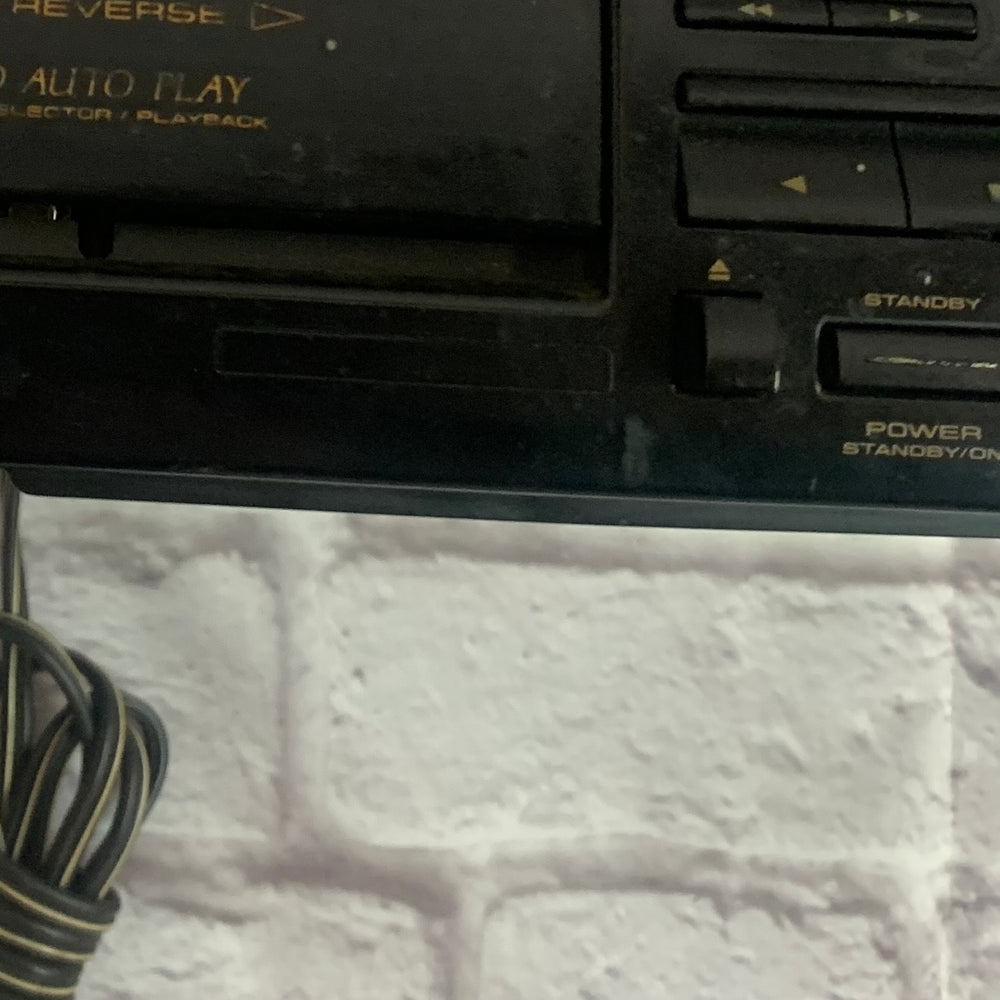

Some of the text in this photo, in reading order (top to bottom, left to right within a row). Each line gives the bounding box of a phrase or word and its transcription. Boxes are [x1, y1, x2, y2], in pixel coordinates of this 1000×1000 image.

[21, 66, 135, 99] AUTO
[152, 73, 253, 104] PLAY
[136, 109, 269, 130] PLAYBACK
[863, 292, 984, 311] STANDBY
[865, 421, 983, 441] POWER
[842, 441, 1000, 461] STANDBY/ON
